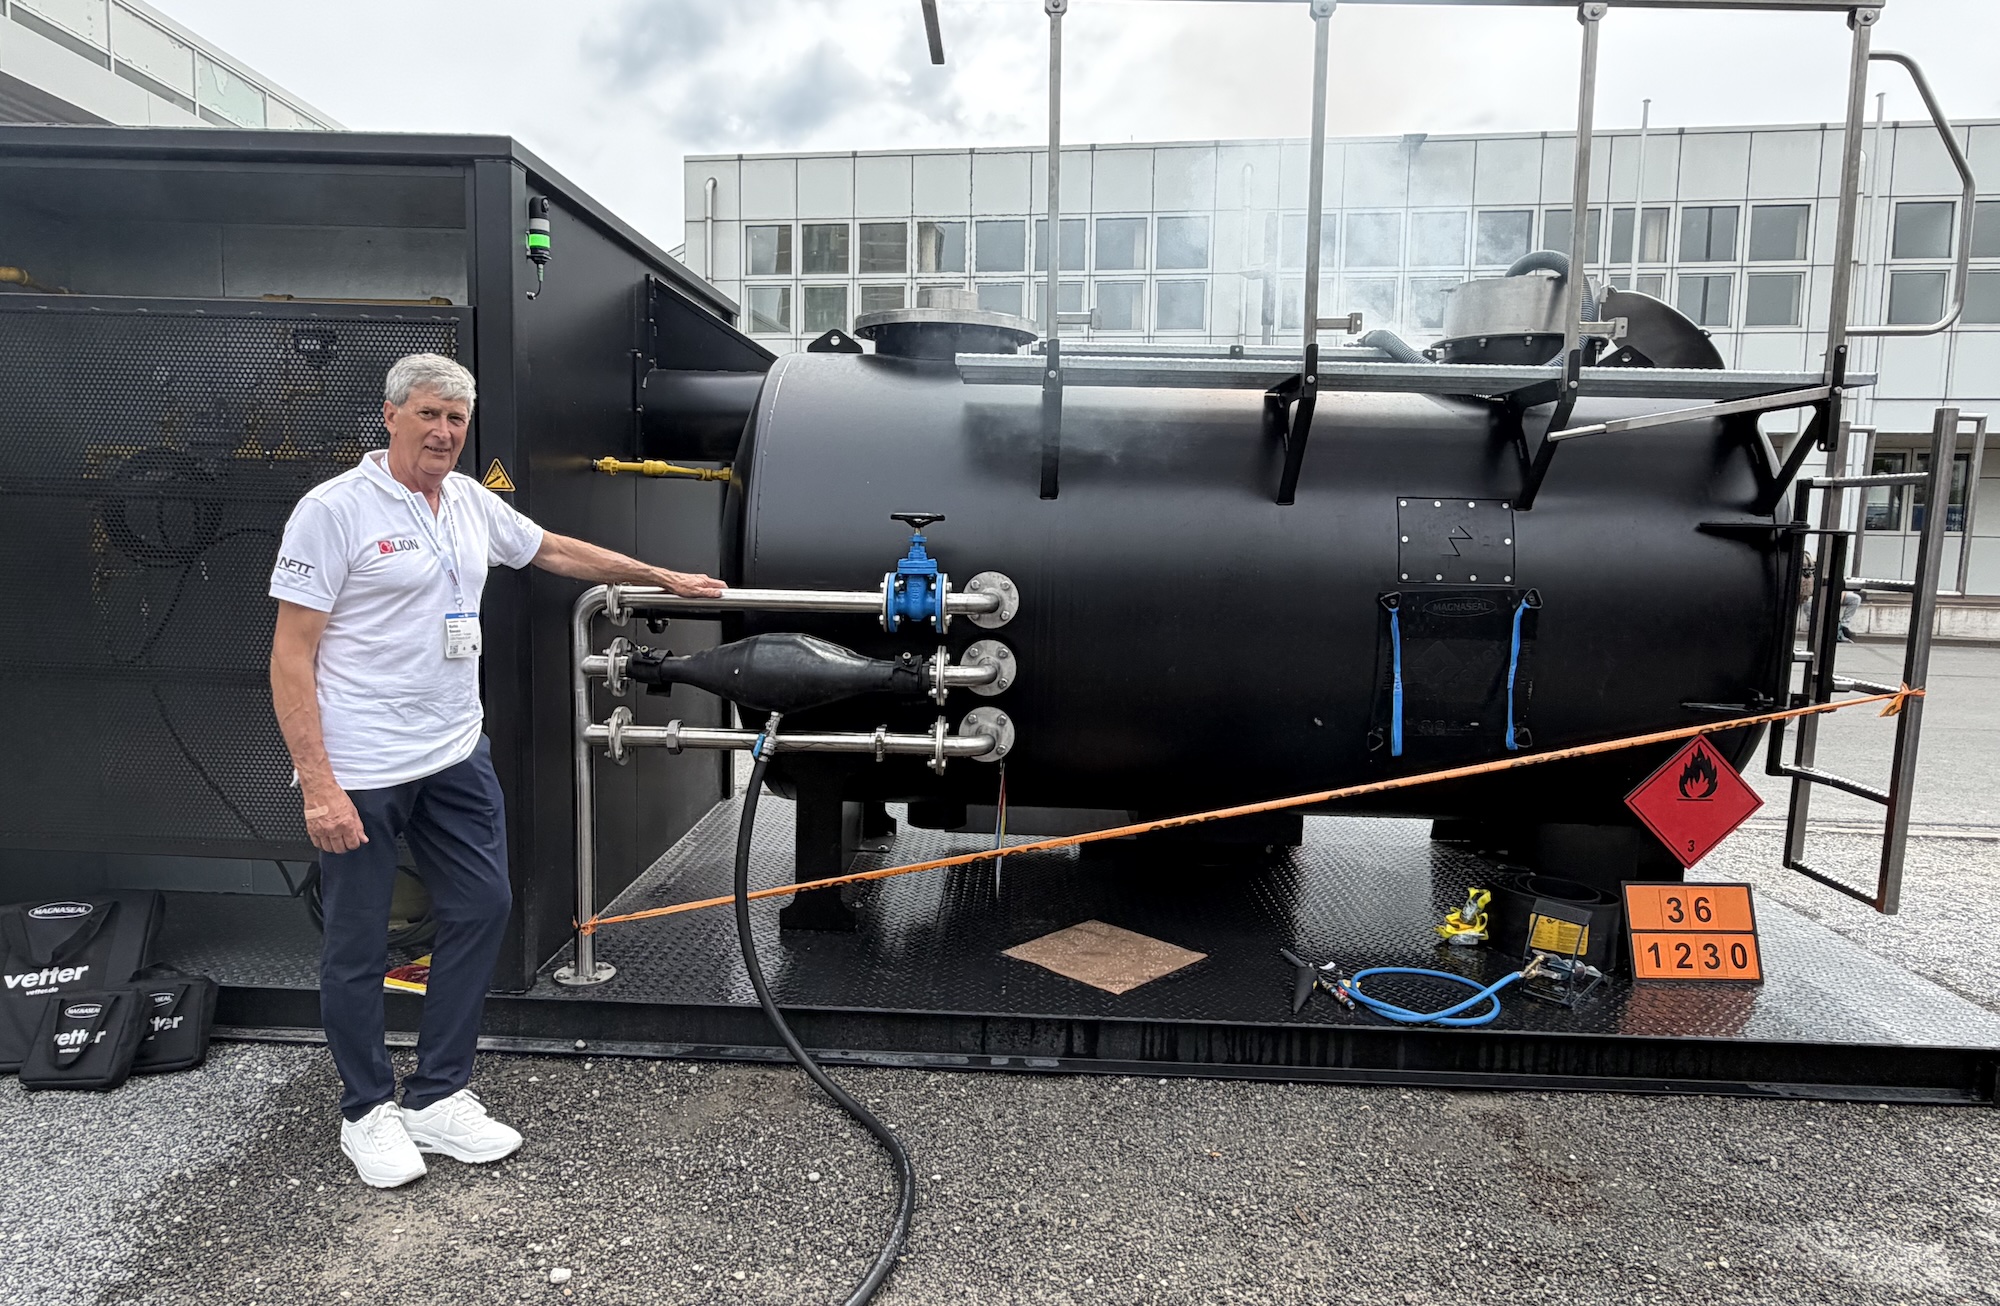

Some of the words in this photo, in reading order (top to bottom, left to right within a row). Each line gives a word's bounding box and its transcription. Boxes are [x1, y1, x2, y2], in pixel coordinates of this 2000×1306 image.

[393, 539, 419, 552] LION
[1432, 602, 1490, 611] MAGNASEAL
[1687, 839, 1695, 852] 3
[33, 906, 87, 915] MAGNASEAL
[1666, 896, 1712, 923] 36
[1647, 942, 1748, 970] 1230
[4, 965, 89, 989] vetter
[26, 986, 59, 996] vetter.de
